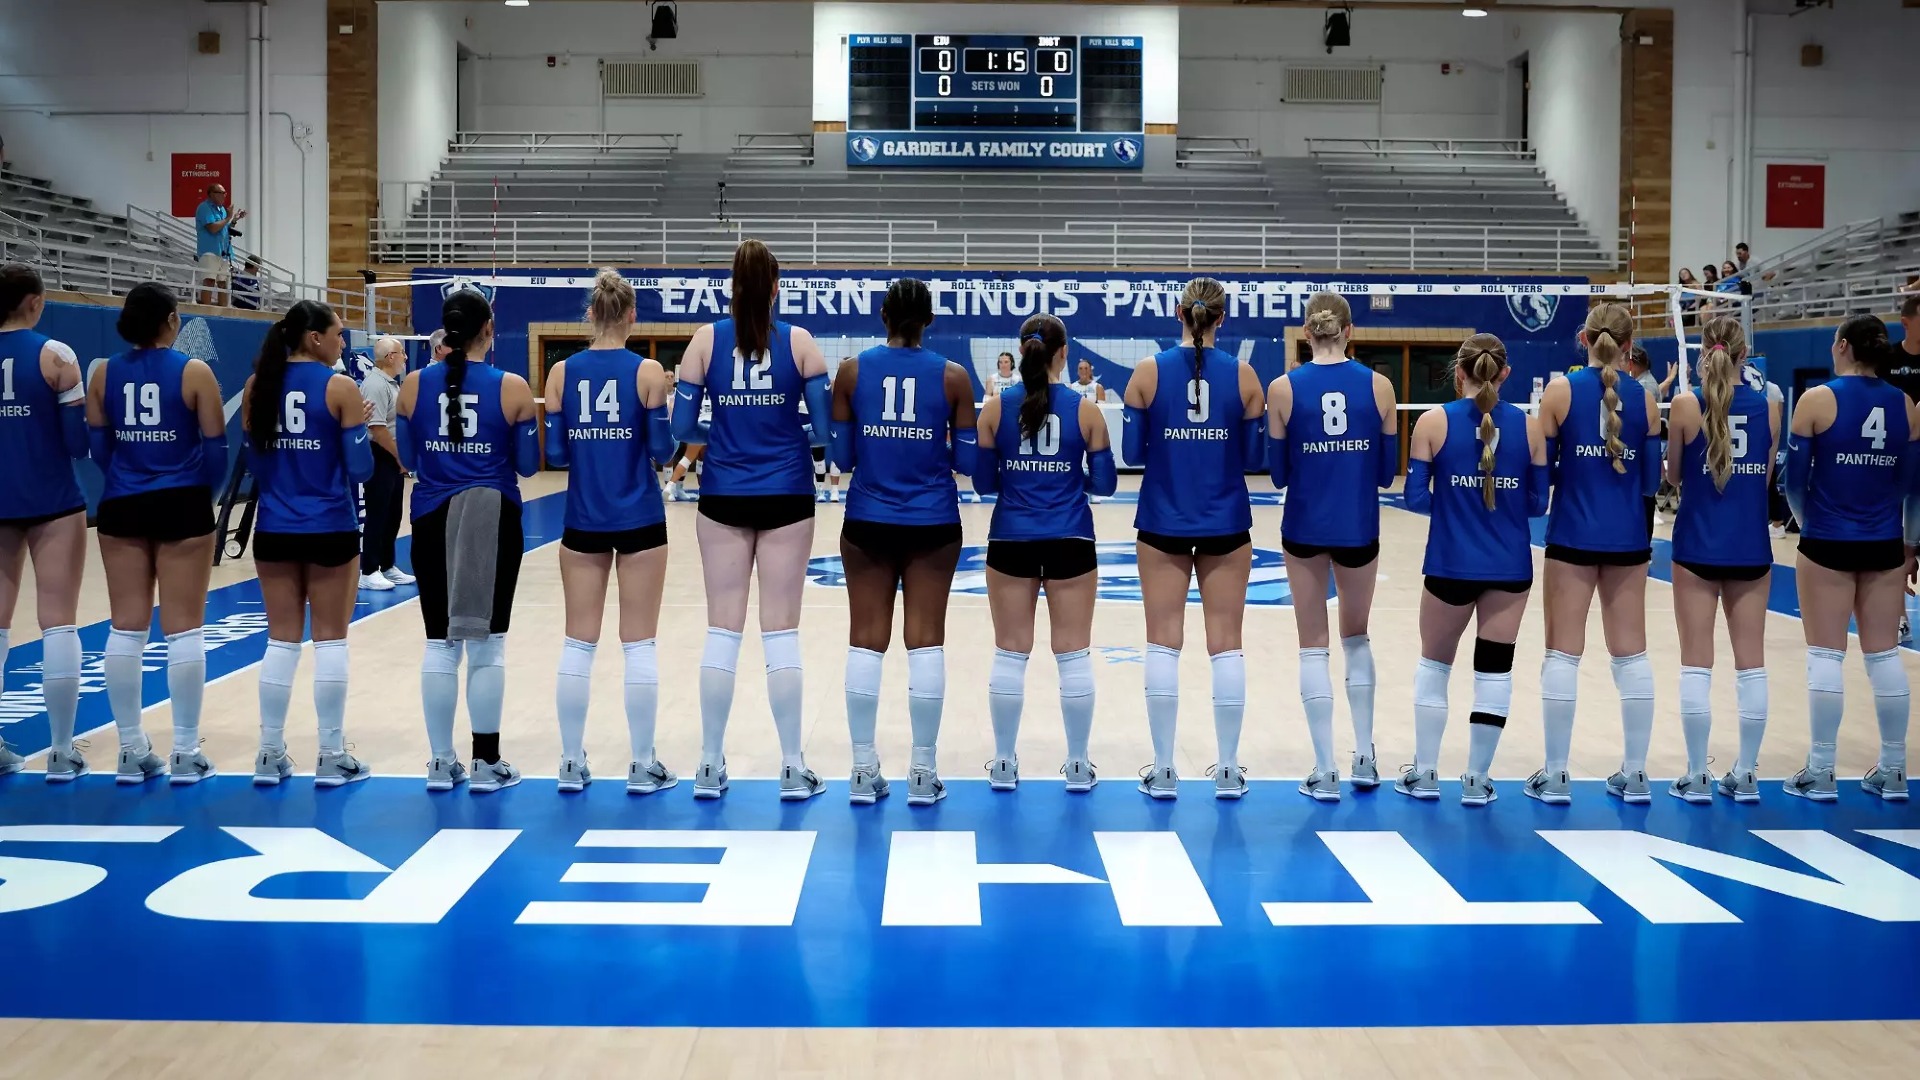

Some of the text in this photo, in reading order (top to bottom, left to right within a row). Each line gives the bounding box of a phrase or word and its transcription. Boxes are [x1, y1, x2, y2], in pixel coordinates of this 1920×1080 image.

[938, 50, 951, 71] 0
[988, 51, 1026, 72] 1:15
[1054, 51, 1067, 72] 0
[938, 75, 951, 96] 0
[972, 81, 1020, 91] SETS WON
[1040, 76, 1053, 96] 0
[883, 141, 1107, 158] GARDELLA FAMILY COURT
[979, 282, 1015, 290] 'THERS
[659, 277, 871, 314] EAERN
[891, 278, 1078, 316] LINOIS
[732, 346, 772, 389] 12
[123, 382, 161, 426] 19
[577, 379, 620, 423] 14
[719, 394, 785, 406] PANTHERS
[882, 376, 916, 422] 11
[1187, 379, 1210, 423] 9
[276, 391, 306, 433] 6
[438, 393, 478, 437] 15
[1320, 392, 1348, 436] 8
[115, 429, 177, 442] PANTHERS
[568, 427, 633, 440] PANTHERS
[863, 425, 933, 440] PANTHERS
[1164, 428, 1229, 440] PANTHERS
[1728, 415, 1747, 458] 5
[1861, 407, 1887, 450] 4
[265, 439, 320, 450] NTHERS
[425, 441, 492, 453] PANTHERS
[1302, 439, 1370, 454] PANTHERS
[1576, 445, 1636, 460] PANTRS
[1006, 460, 1071, 472] PANTHERS
[1702, 463, 1766, 474] PTHERS
[1836, 453, 1898, 467] PANTHERS
[1451, 474, 1519, 488] PANTERS
